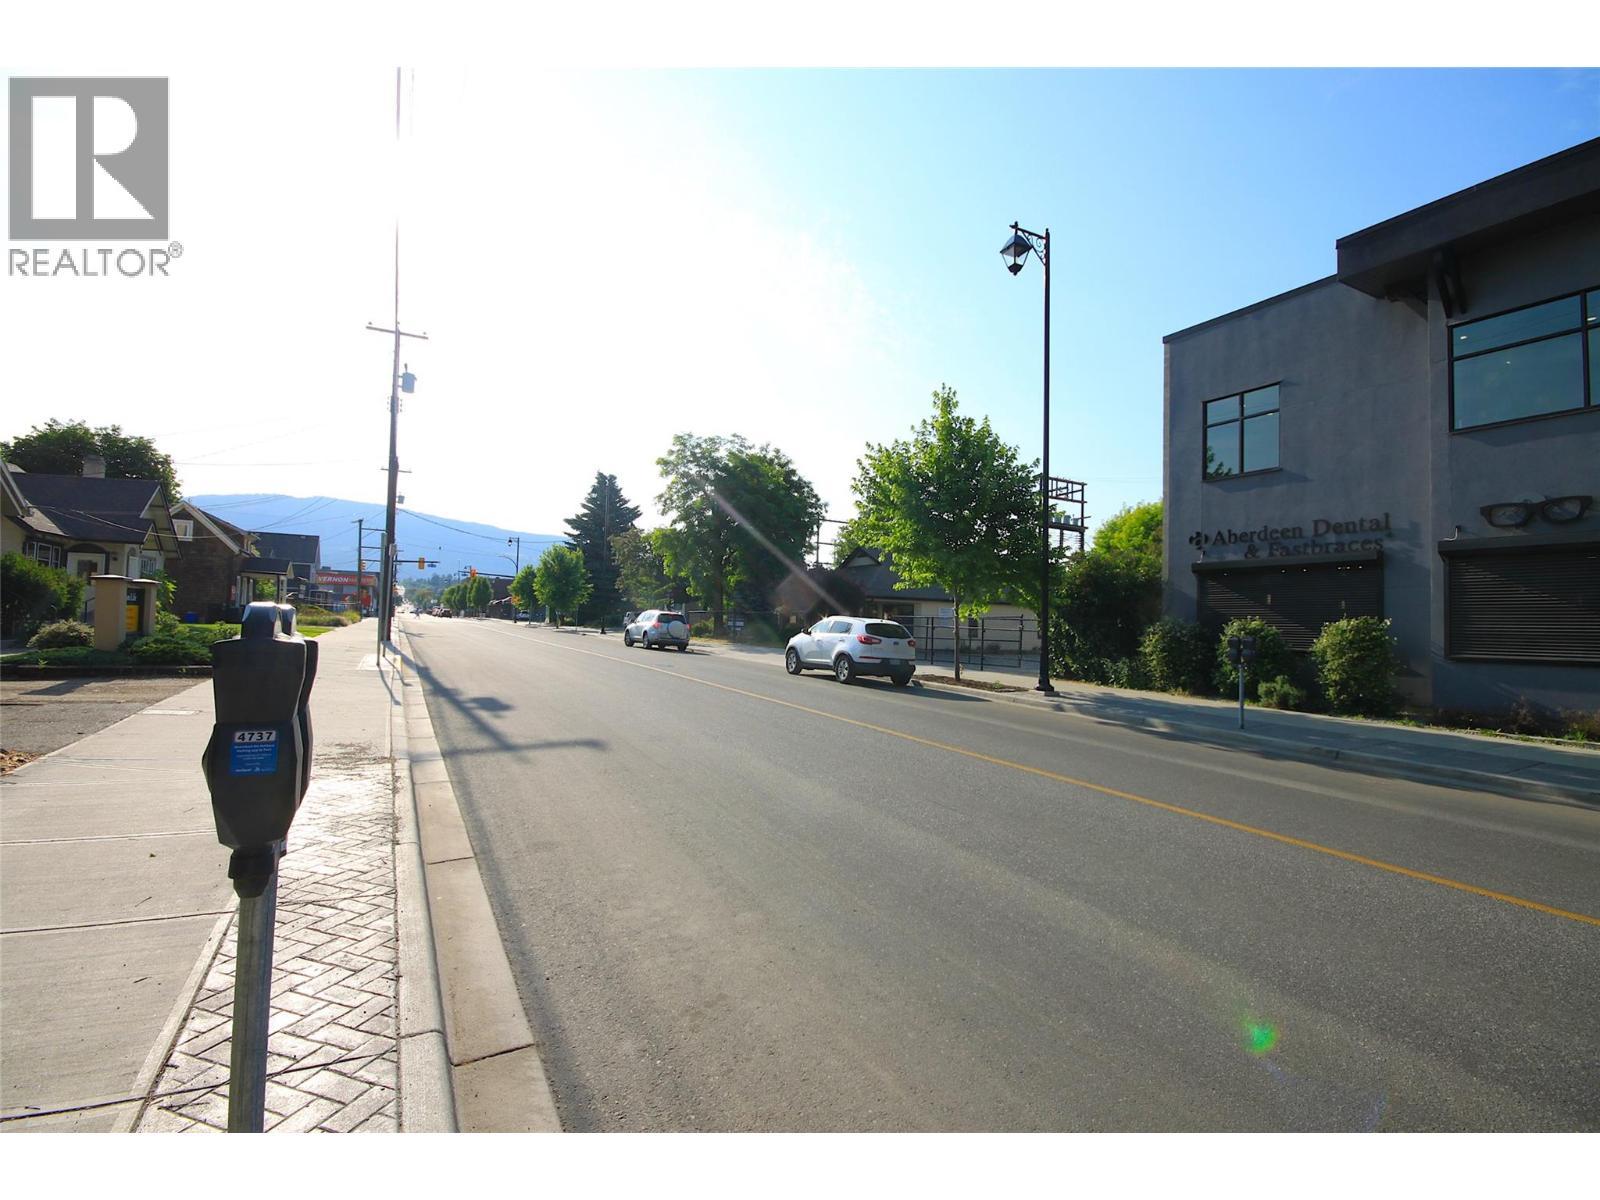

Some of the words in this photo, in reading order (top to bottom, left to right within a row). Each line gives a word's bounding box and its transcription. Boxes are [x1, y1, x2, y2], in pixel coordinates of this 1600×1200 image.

[1212, 525, 1304, 546] Aberdeen
[1312, 512, 1391, 537] Dental
[1244, 543, 1260, 559] &
[1268, 537, 1384, 558] Fastbraces
[237, 731, 273, 741] 4737
